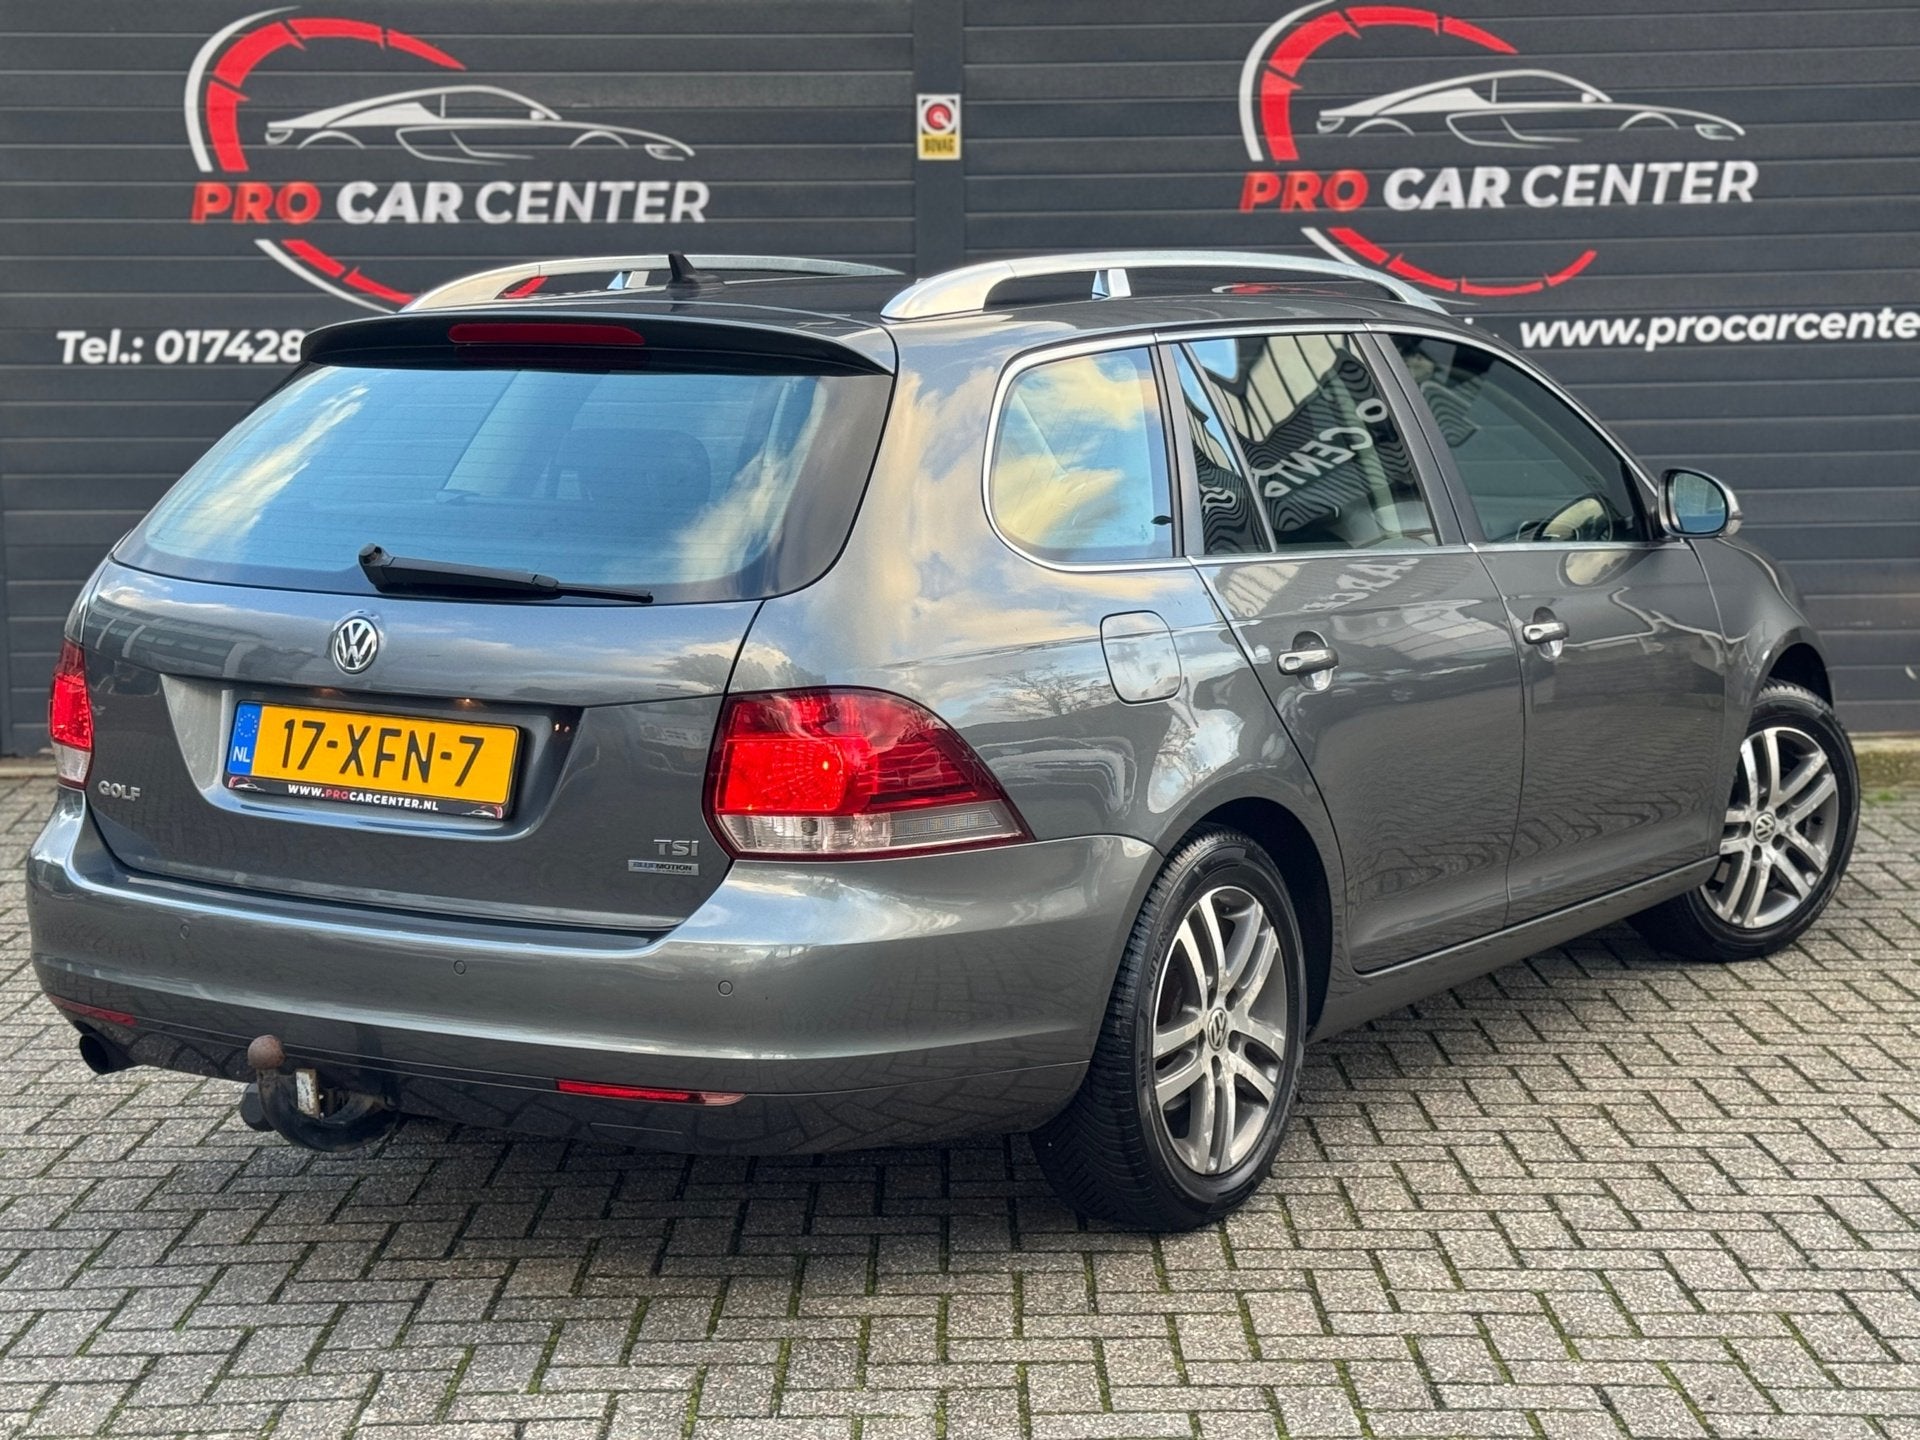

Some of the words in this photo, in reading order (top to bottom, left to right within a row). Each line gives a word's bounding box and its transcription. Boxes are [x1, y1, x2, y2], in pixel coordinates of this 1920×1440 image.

[190, 181, 321, 224] PRO
[336, 181, 463, 224] CAR
[475, 181, 710, 224] CENTER
[1239, 169, 1369, 213] PRO
[1383, 166, 1510, 211] CAR
[1521, 160, 1759, 208] CENTER
[1519, 306, 1920, 352] www.procarcente
[56, 328, 142, 364] Tel.:
[154, 329, 306, 364] 017428
[232, 745, 251, 763] NL
[281, 718, 485, 787] 17-XFN-7
[98, 779, 141, 802] GOLF
[287, 783, 440, 812] WWW.PROCARCENTER.NL
[653, 838, 700, 857] TSI
[632, 861, 692, 872] BLUEMOTION
